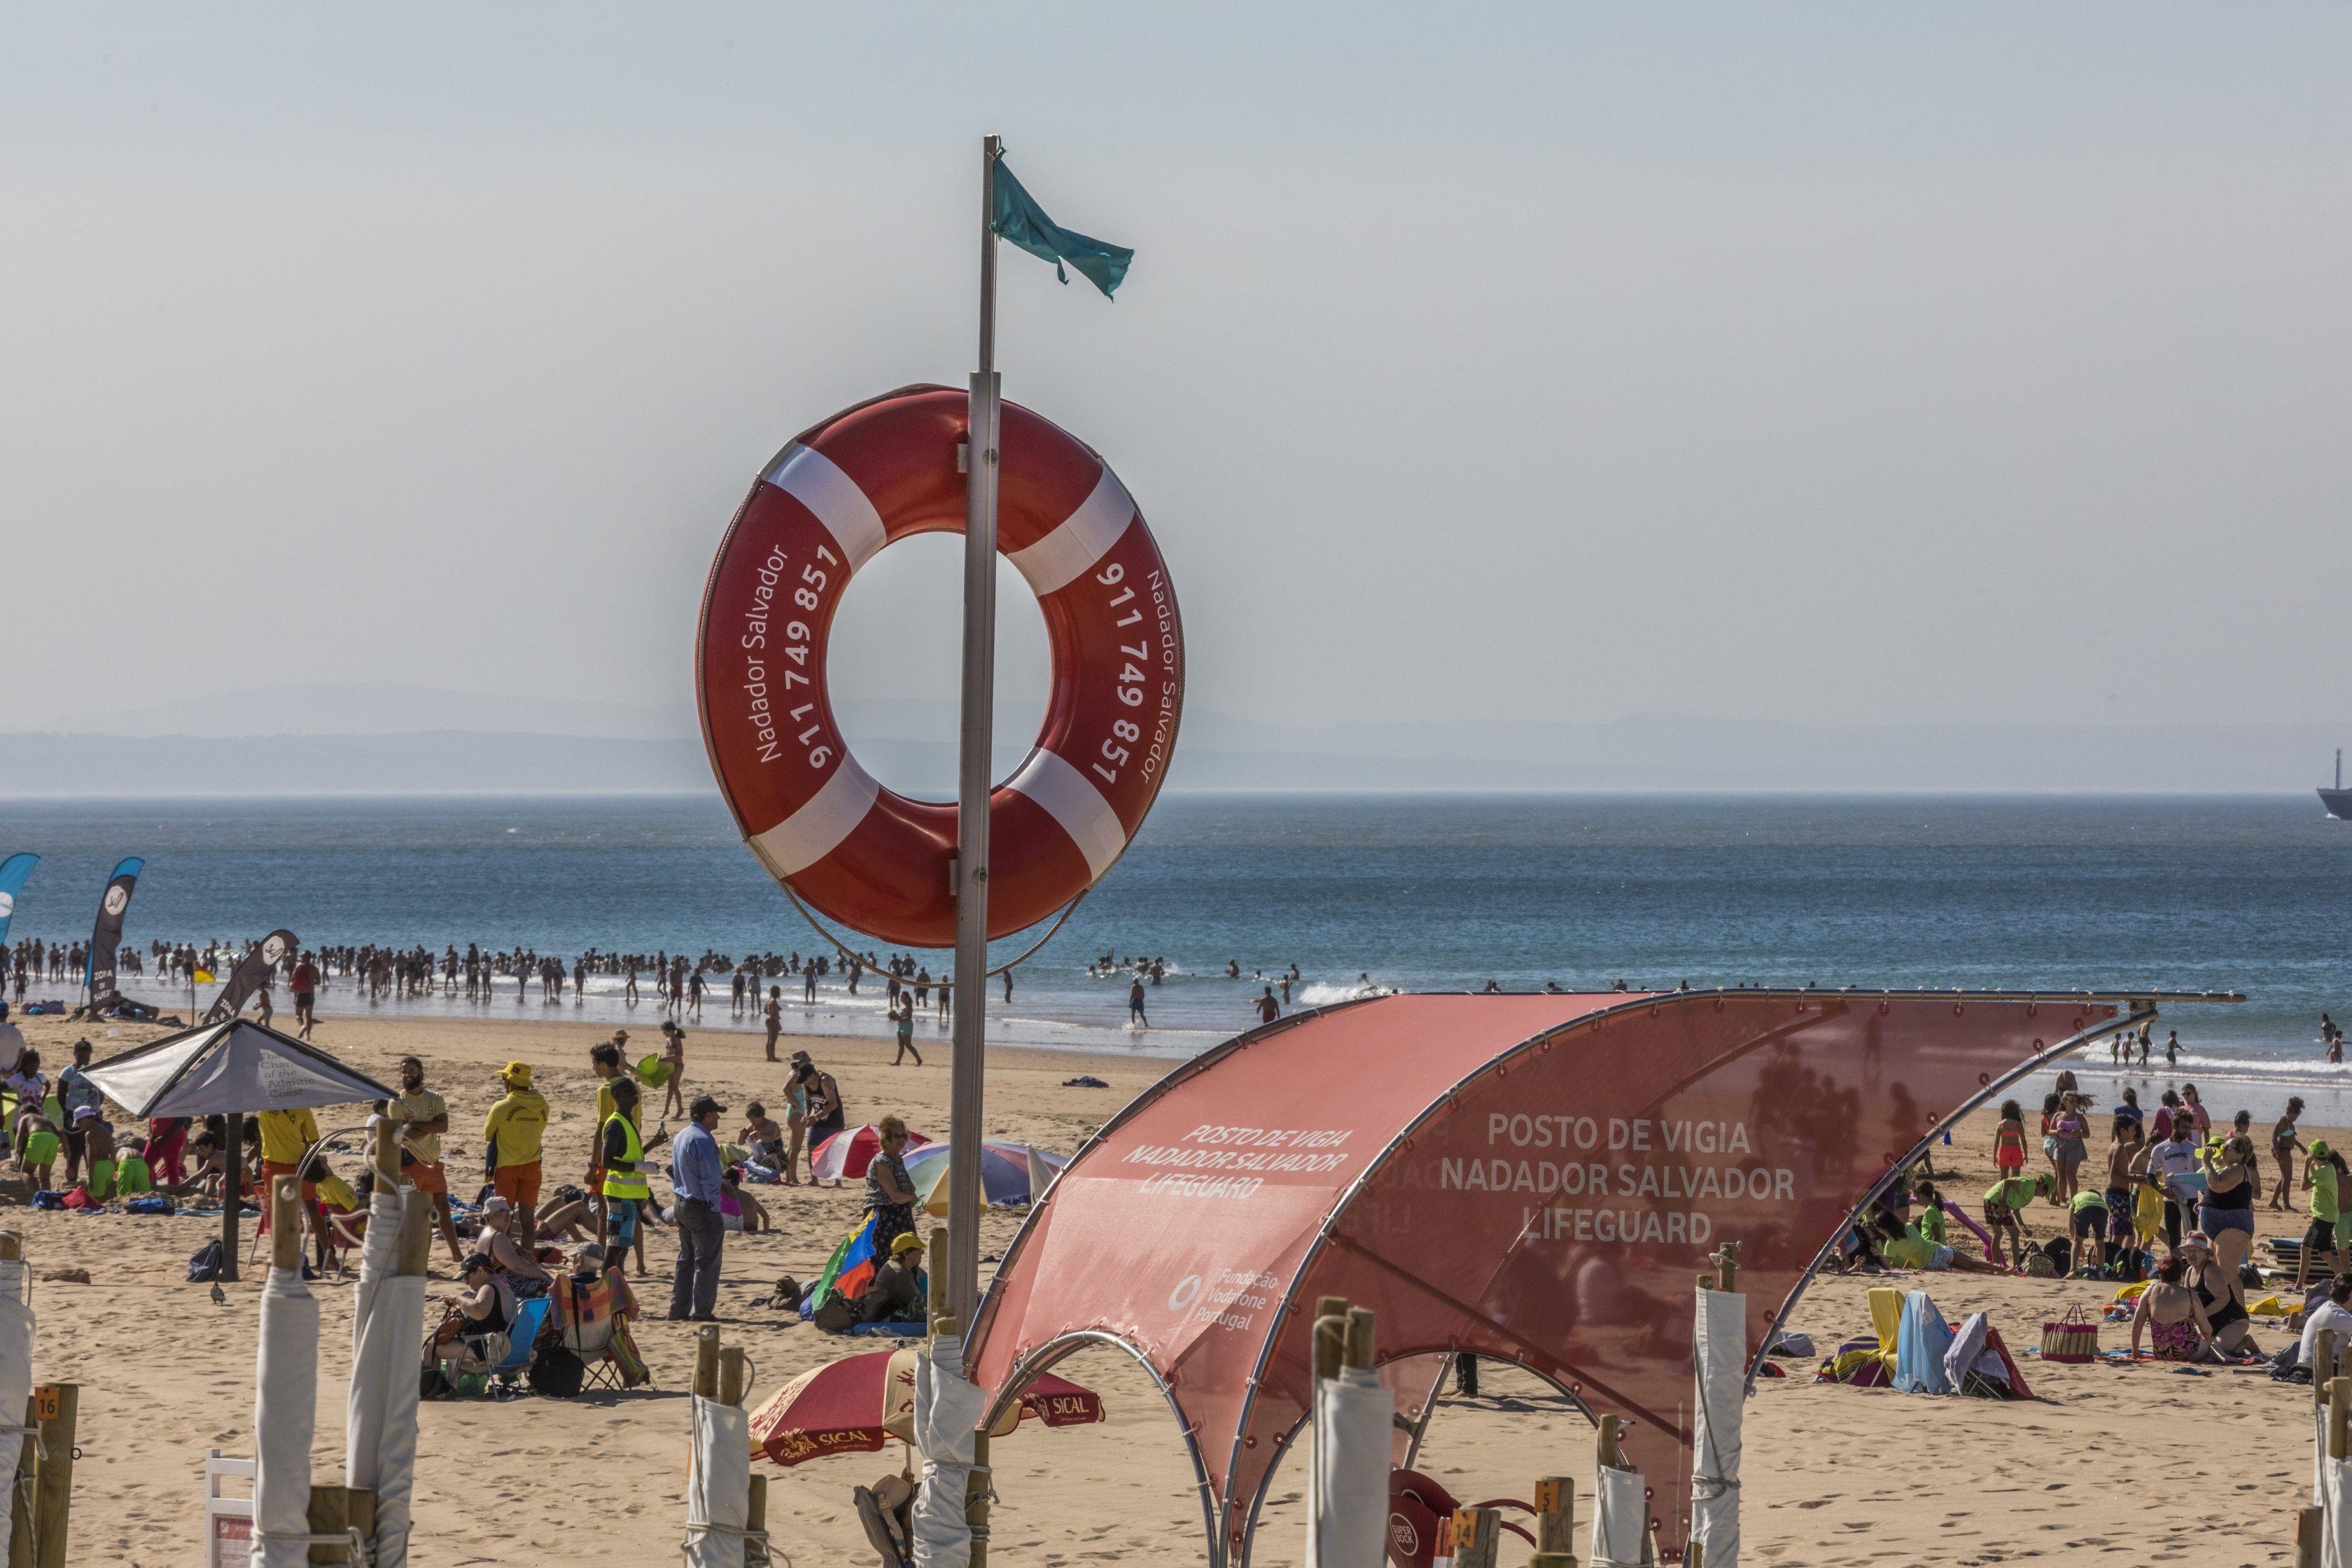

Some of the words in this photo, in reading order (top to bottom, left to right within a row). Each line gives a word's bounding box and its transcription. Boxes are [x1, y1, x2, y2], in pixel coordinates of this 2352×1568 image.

[794, 544, 838, 611] 851
[742, 544, 788, 649] Salvador
[1096, 563, 1142, 627] 911
[1147, 570, 1175, 675] Nadador
[785, 621, 811, 690] 749
[1116, 640, 1148, 707] 749
[743, 656, 782, 763] Nadador
[790, 703, 833, 769] 911
[1141, 681, 1176, 784] Salvador
[1092, 719, 1140, 784] 851
[264, 1070, 276, 1078] of
[279, 1069, 297, 1077] the
[268, 1079, 315, 1088] Atlantic
[270, 1088, 304, 1098] Coast
[1182, 1124, 1261, 1145] POSTO
[1254, 1128, 1295, 1147] DE
[1292, 1129, 1354, 1147] VIGIA
[1488, 1113, 1598, 1149] POSTO
[1608, 1118, 1652, 1151] DE
[1660, 1120, 1751, 1154] VIGIA
[1121, 1144, 1238, 1168] NADADOR
[1232, 1152, 1349, 1172] SALVADOR
[1140, 1172, 1264, 1198] LIFEGUARD
[1441, 1157, 1609, 1196] NADADOR
[1618, 1163, 1795, 1200] SALVADOR
[1522, 1206, 1712, 1244] LIFEGUARD
[1217, 1268, 1278, 1289] Fundação
[1207, 1287, 1266, 1310] Vodafone
[1194, 1306, 1253, 1331] Portugal
[40, 1399, 55, 1414] 16
[1052, 1396, 1090, 1414] SICAL
[819, 1430, 872, 1446] SICAL
[1542, 1492, 1550, 1506] 5
[1392, 1524, 1413, 1535] SUPER
[1395, 1534, 1414, 1544] BOCK
[1456, 1523, 1471, 1541] 14
